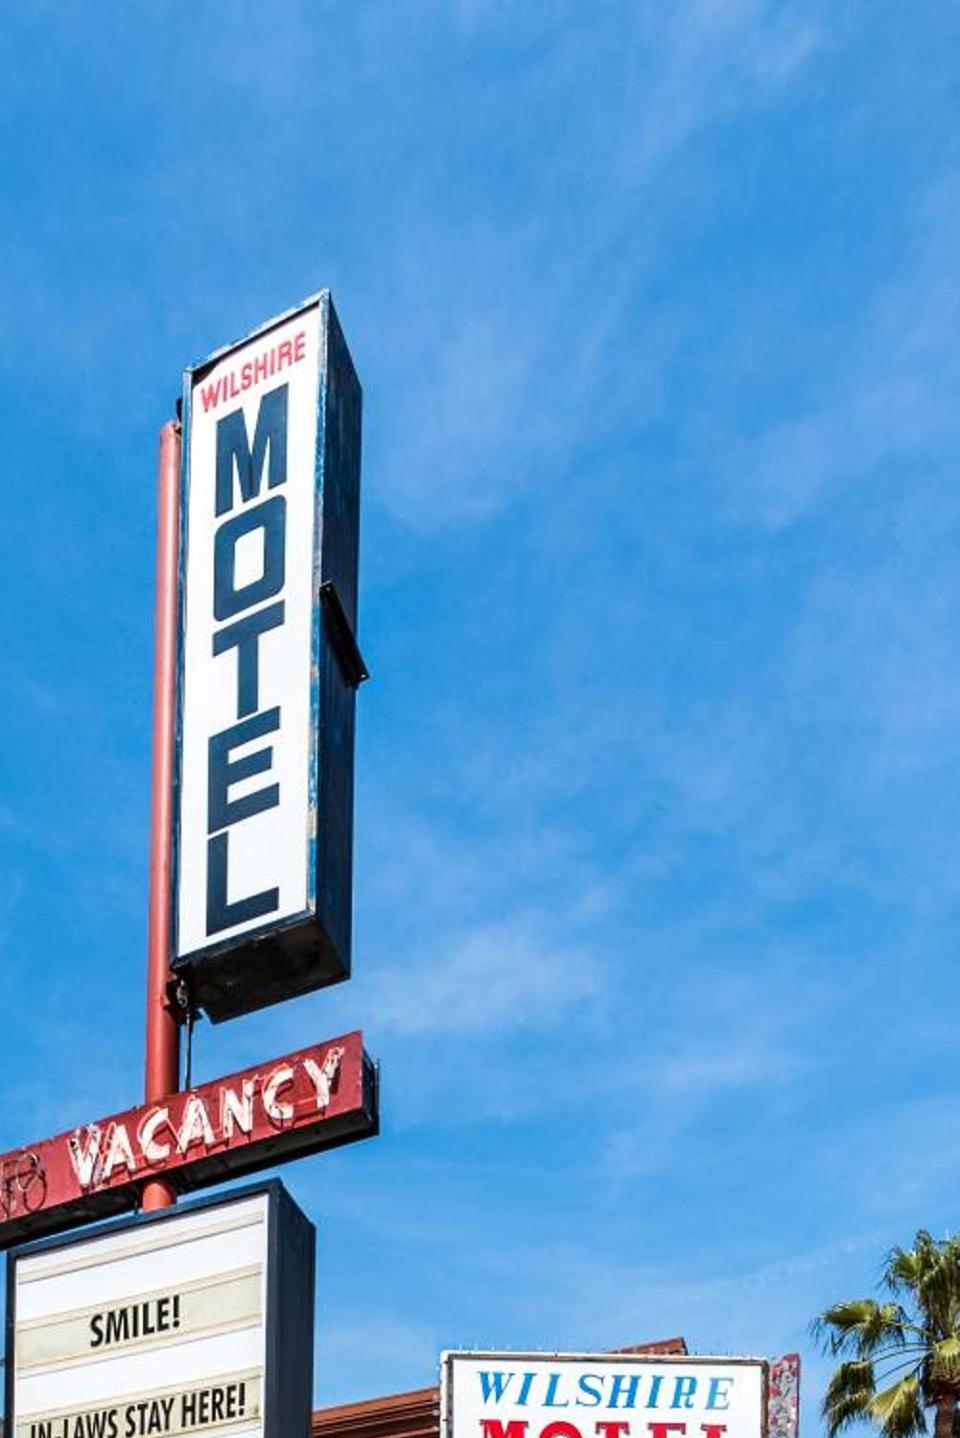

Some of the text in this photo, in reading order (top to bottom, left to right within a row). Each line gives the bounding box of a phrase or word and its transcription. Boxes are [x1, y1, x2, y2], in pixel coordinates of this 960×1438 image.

[201, 331, 306, 413] WILSHIRE
[206, 381, 289, 937] MOTEL
[66, 1047, 345, 1188] VACANCY
[90, 1295, 180, 1347] SMILE!
[125, 1397, 174, 1438] STAY
[181, 1382, 246, 1428] HERE!
[476, 1371, 734, 1410] WILSHIRE
